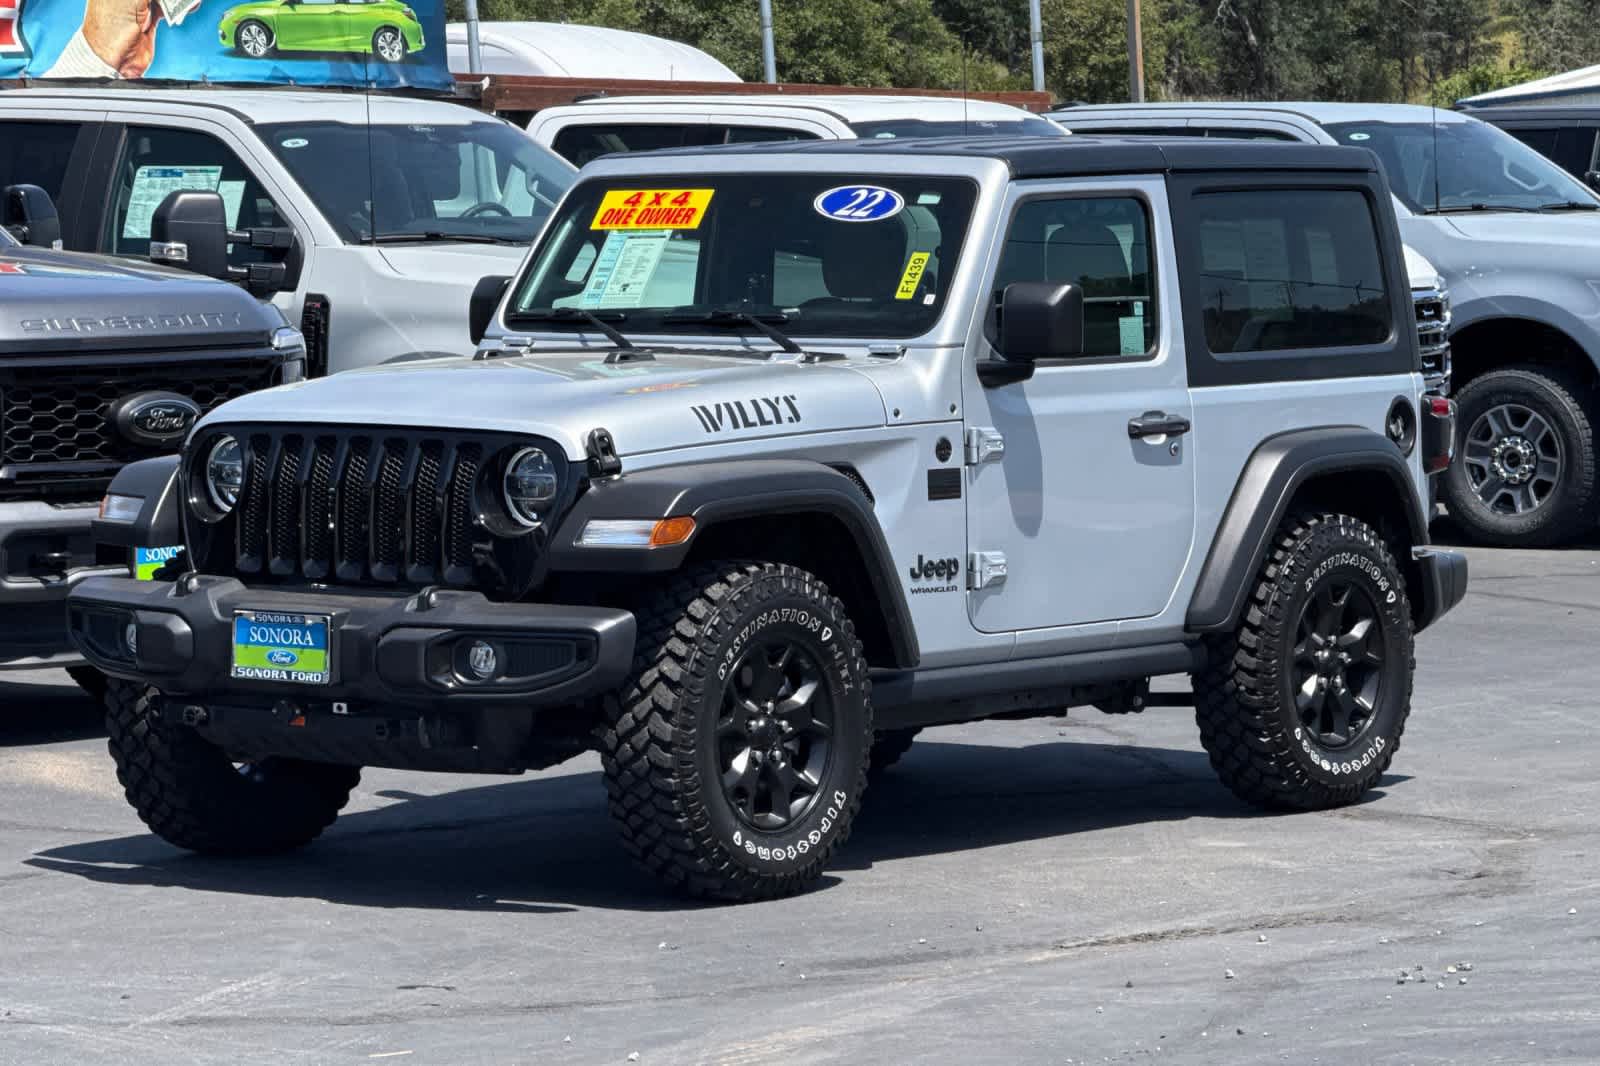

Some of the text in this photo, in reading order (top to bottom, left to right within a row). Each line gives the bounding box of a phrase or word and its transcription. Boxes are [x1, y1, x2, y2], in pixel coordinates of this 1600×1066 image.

[623, 191, 645, 207] 4
[671, 191, 693, 207] 4
[832, 188, 887, 217] 22
[599, 207, 697, 226] ONE OWNER
[900, 257, 925, 294] F1439
[20, 316, 155, 332] SUPER
[146, 407, 185, 430] Ford
[689, 394, 802, 433] WILLYS
[909, 554, 960, 580] Jeep
[1305, 552, 1390, 592] DESTINATION
[910, 585, 958, 594] WRANGLER
[255, 613, 292, 624] SONORA
[249, 626, 314, 646] SONORA
[717, 608, 822, 681] DESTINATION
[271, 650, 292, 664] Ford
[237, 667, 322, 682] SONORA FORD
[1302, 736, 1385, 775] Firestone
[744, 790, 847, 860] Firestone
